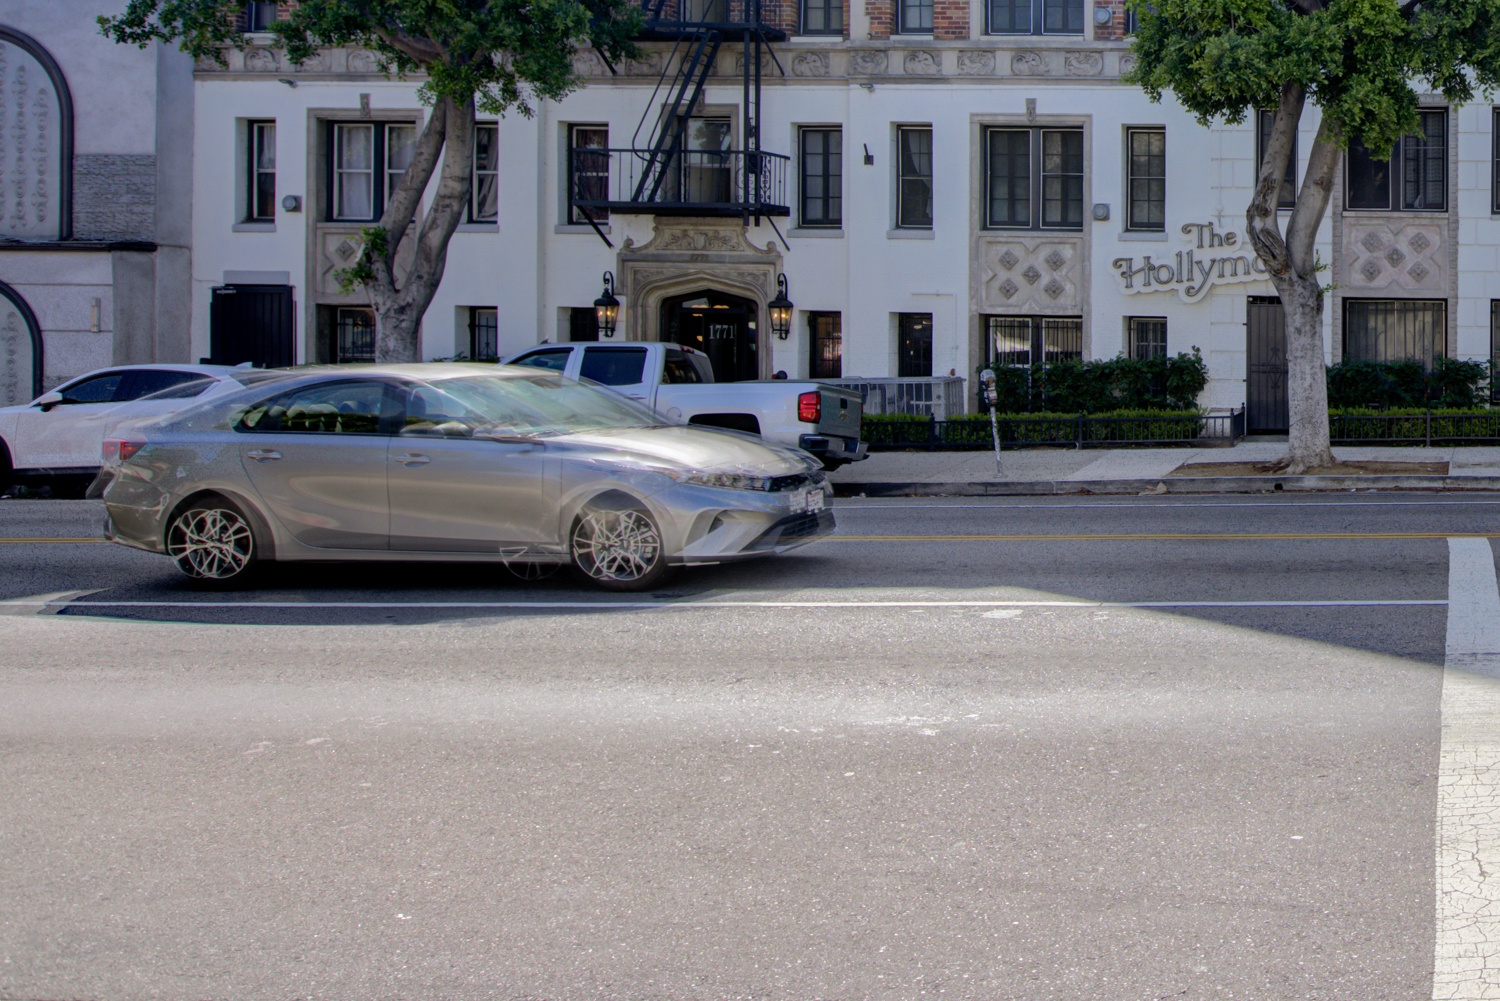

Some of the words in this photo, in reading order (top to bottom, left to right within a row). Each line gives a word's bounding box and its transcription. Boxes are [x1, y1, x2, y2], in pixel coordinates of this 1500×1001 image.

[1181, 221, 1237, 249] The
[1112, 249, 1269, 297] Hollymo
[709, 324, 735, 339] 1771
